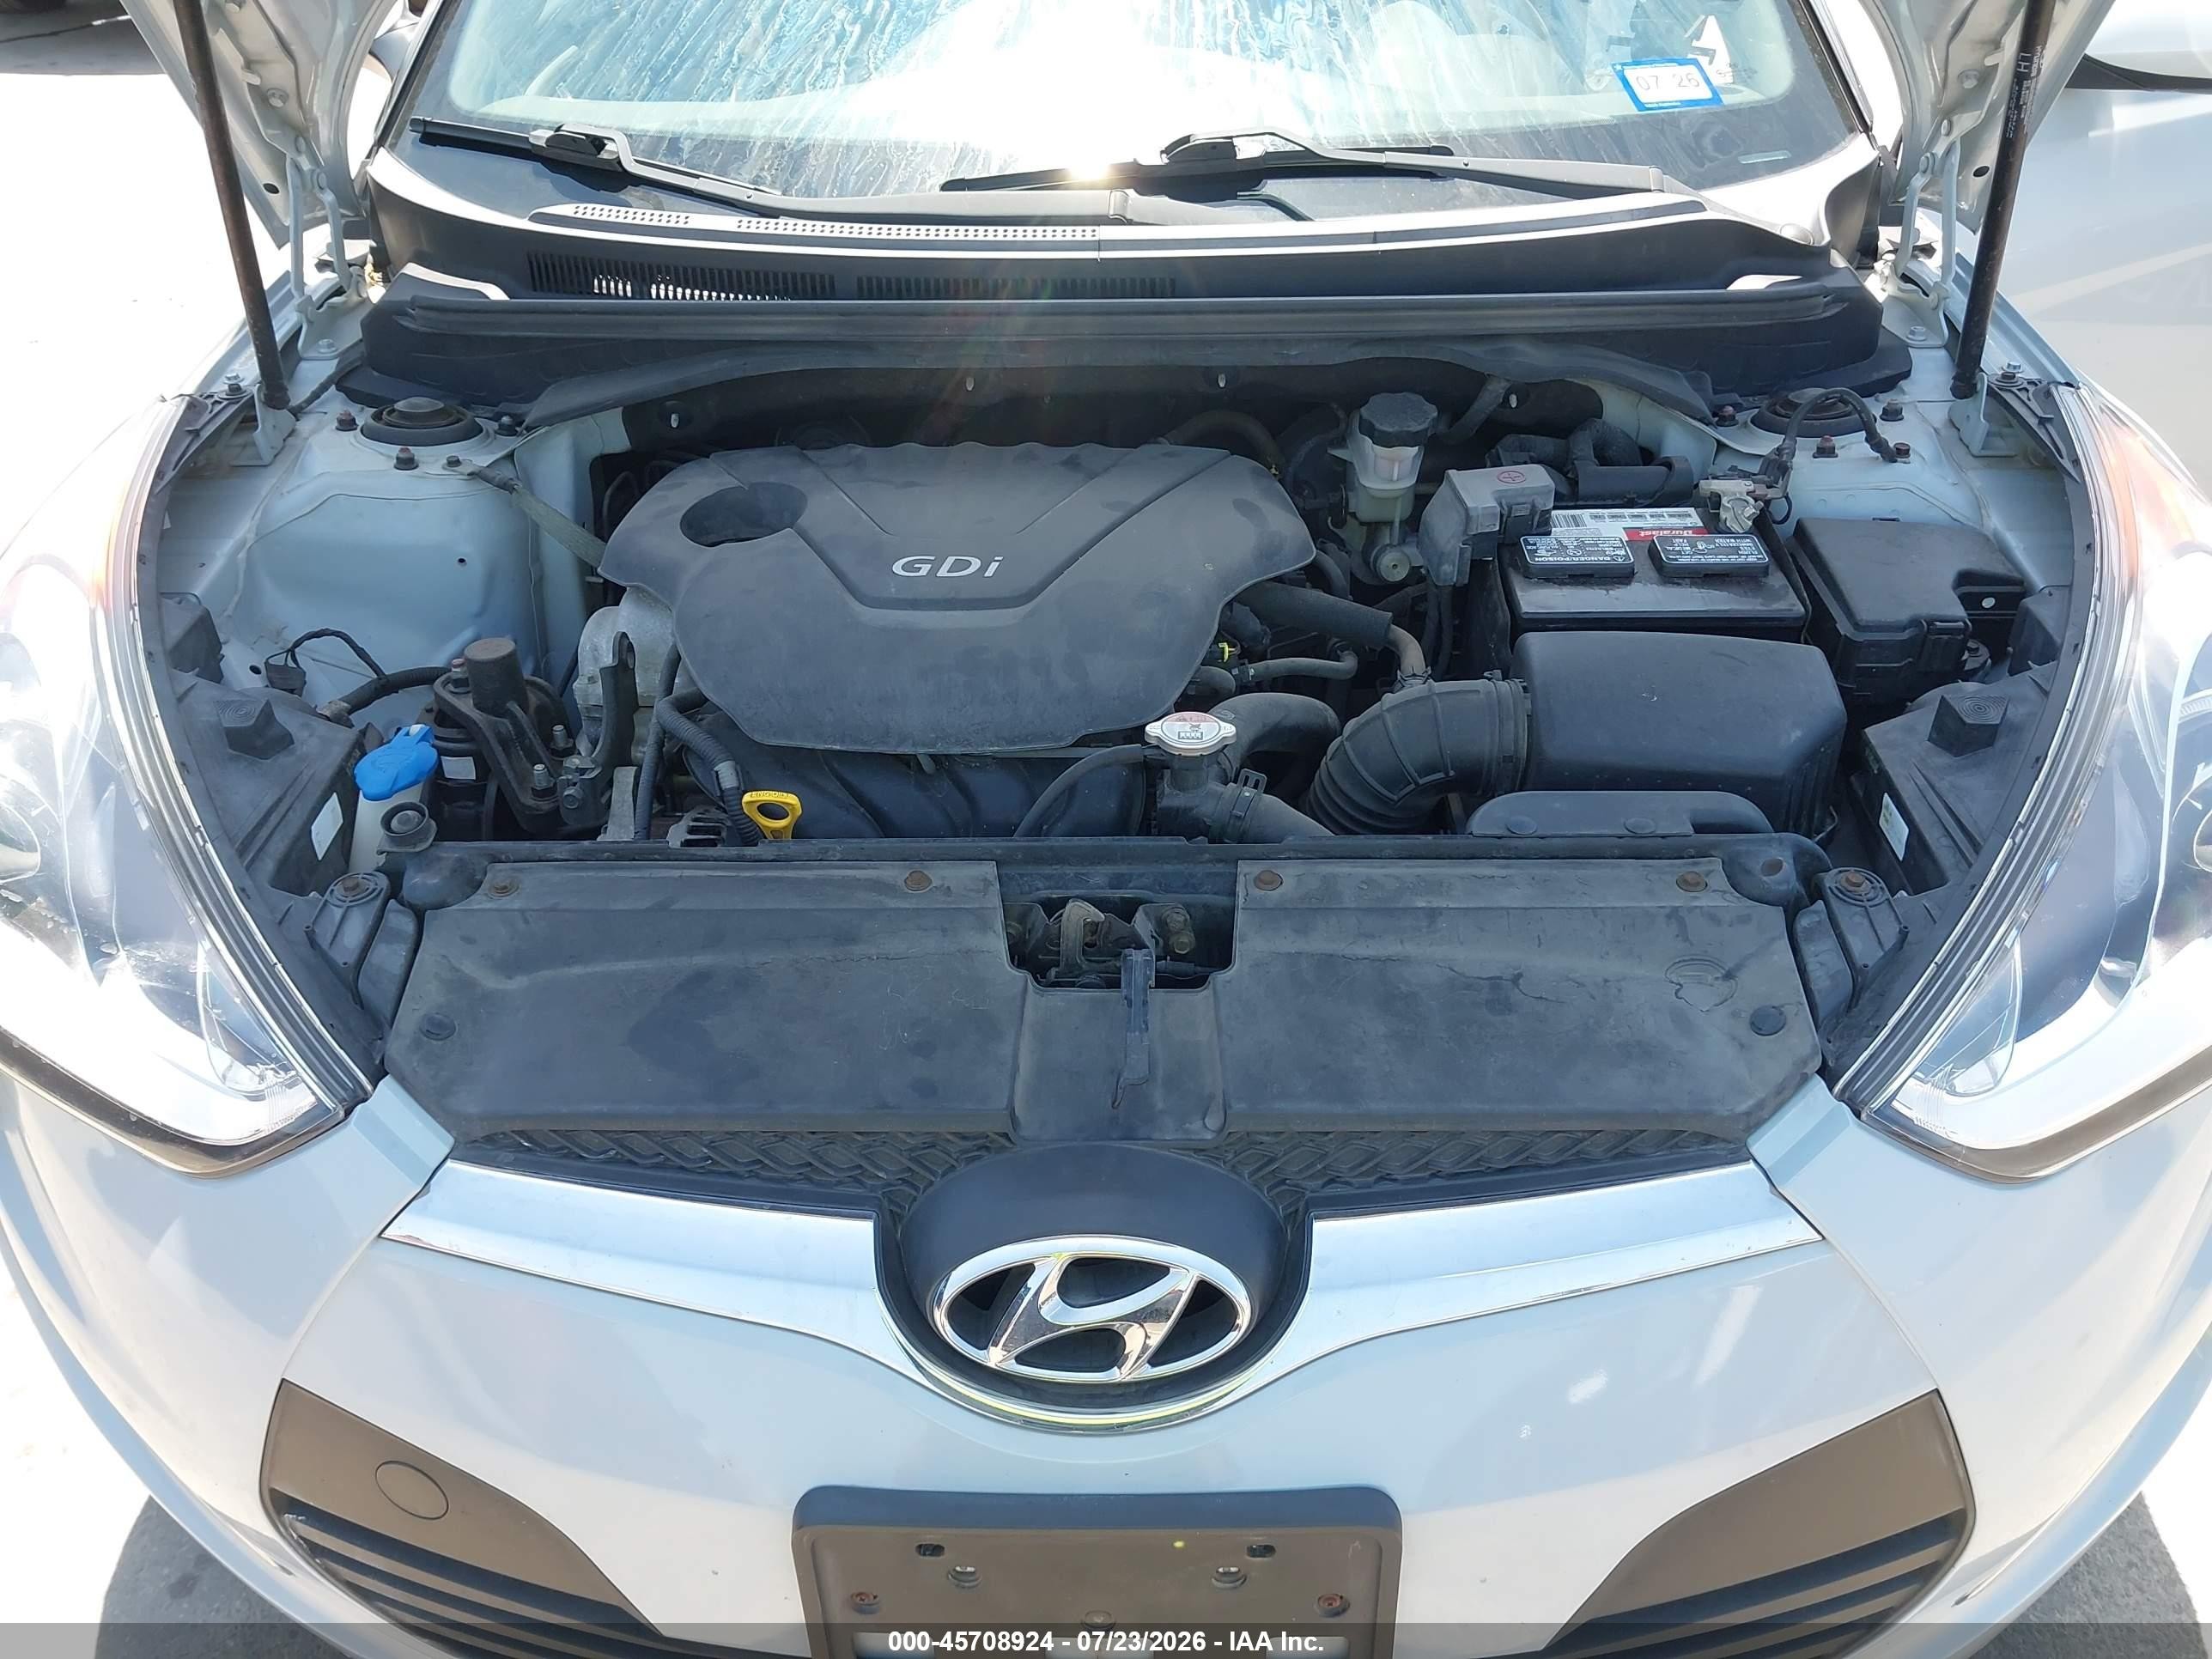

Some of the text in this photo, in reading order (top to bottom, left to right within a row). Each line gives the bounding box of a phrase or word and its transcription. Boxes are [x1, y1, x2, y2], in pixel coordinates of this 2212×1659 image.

[2017, 52, 2032, 72] LH
[1636, 75, 1659, 90] 07
[892, 556, 1004, 577] GDi
